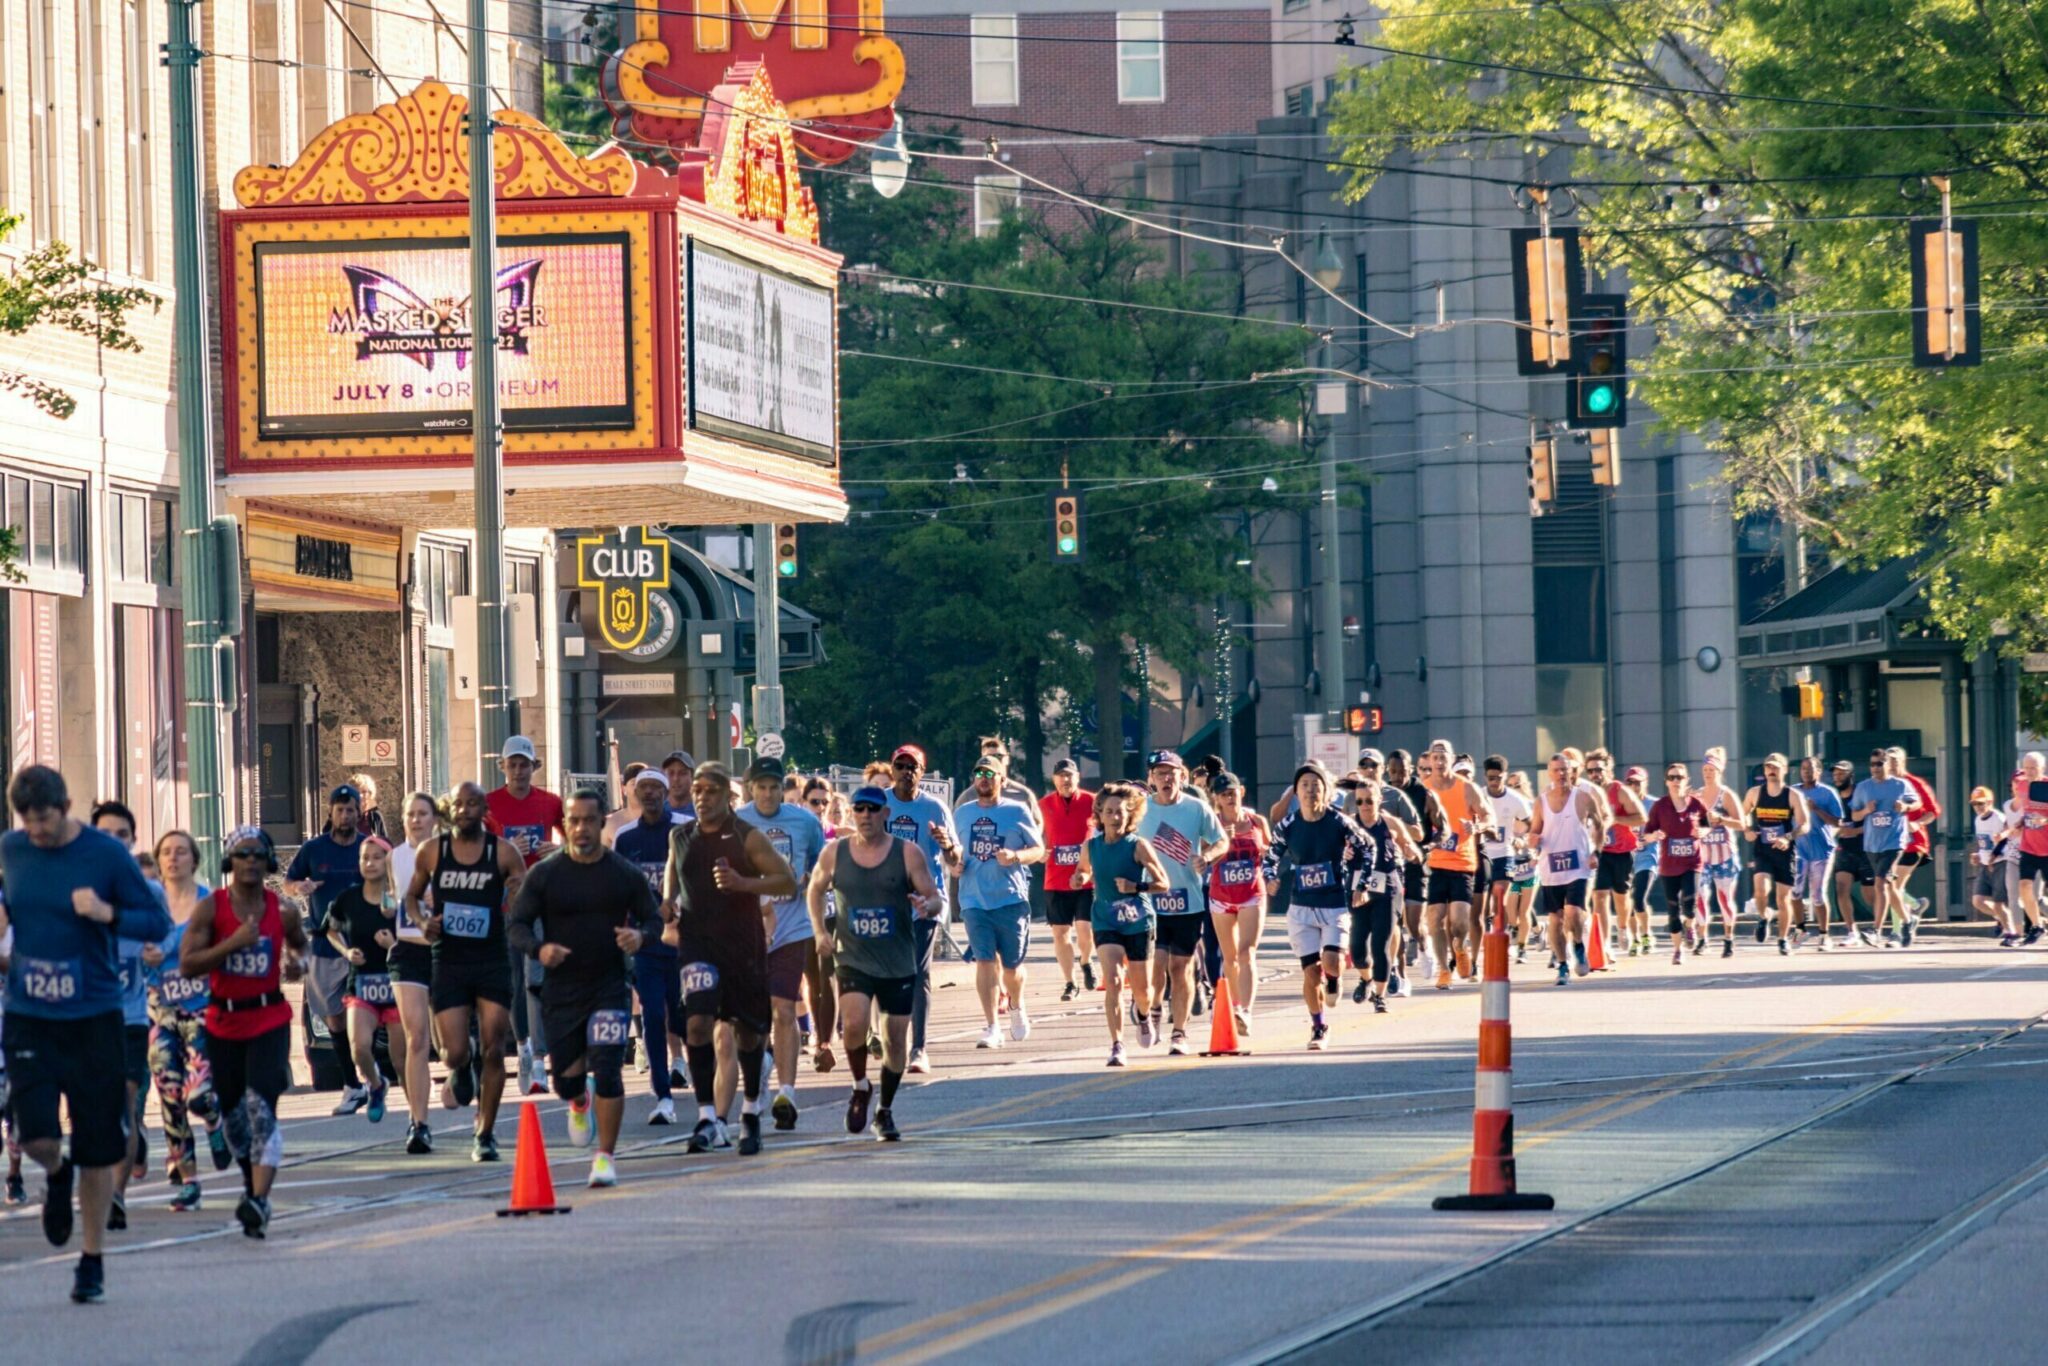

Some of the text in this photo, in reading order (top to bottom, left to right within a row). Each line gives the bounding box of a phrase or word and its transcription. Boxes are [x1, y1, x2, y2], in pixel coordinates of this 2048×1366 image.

[434, 297, 454, 307] THE
[329, 305, 548, 334] MASKED SIGER
[369, 337, 438, 351] NATIONAL
[439, 336, 472, 350] TOUR
[333, 384, 390, 400] JULY
[401, 384, 414, 399] 8
[593, 549, 655, 578] CLUB
[1371, 709, 1381, 731] 3
[972, 841, 1000, 856] 1895
[1671, 845, 1693, 855] 1205
[1057, 852, 1080, 865] 1469
[1555, 858, 1572, 869] 717
[1223, 868, 1252, 883] 1665
[1300, 871, 1328, 887] 1647
[1156, 897, 1185, 911] 1008
[446, 915, 486, 934] 2067
[853, 917, 890, 935] 1982
[24, 973, 76, 998] 1248
[163, 978, 204, 1001] 1286
[592, 1022, 627, 1042] 1291
